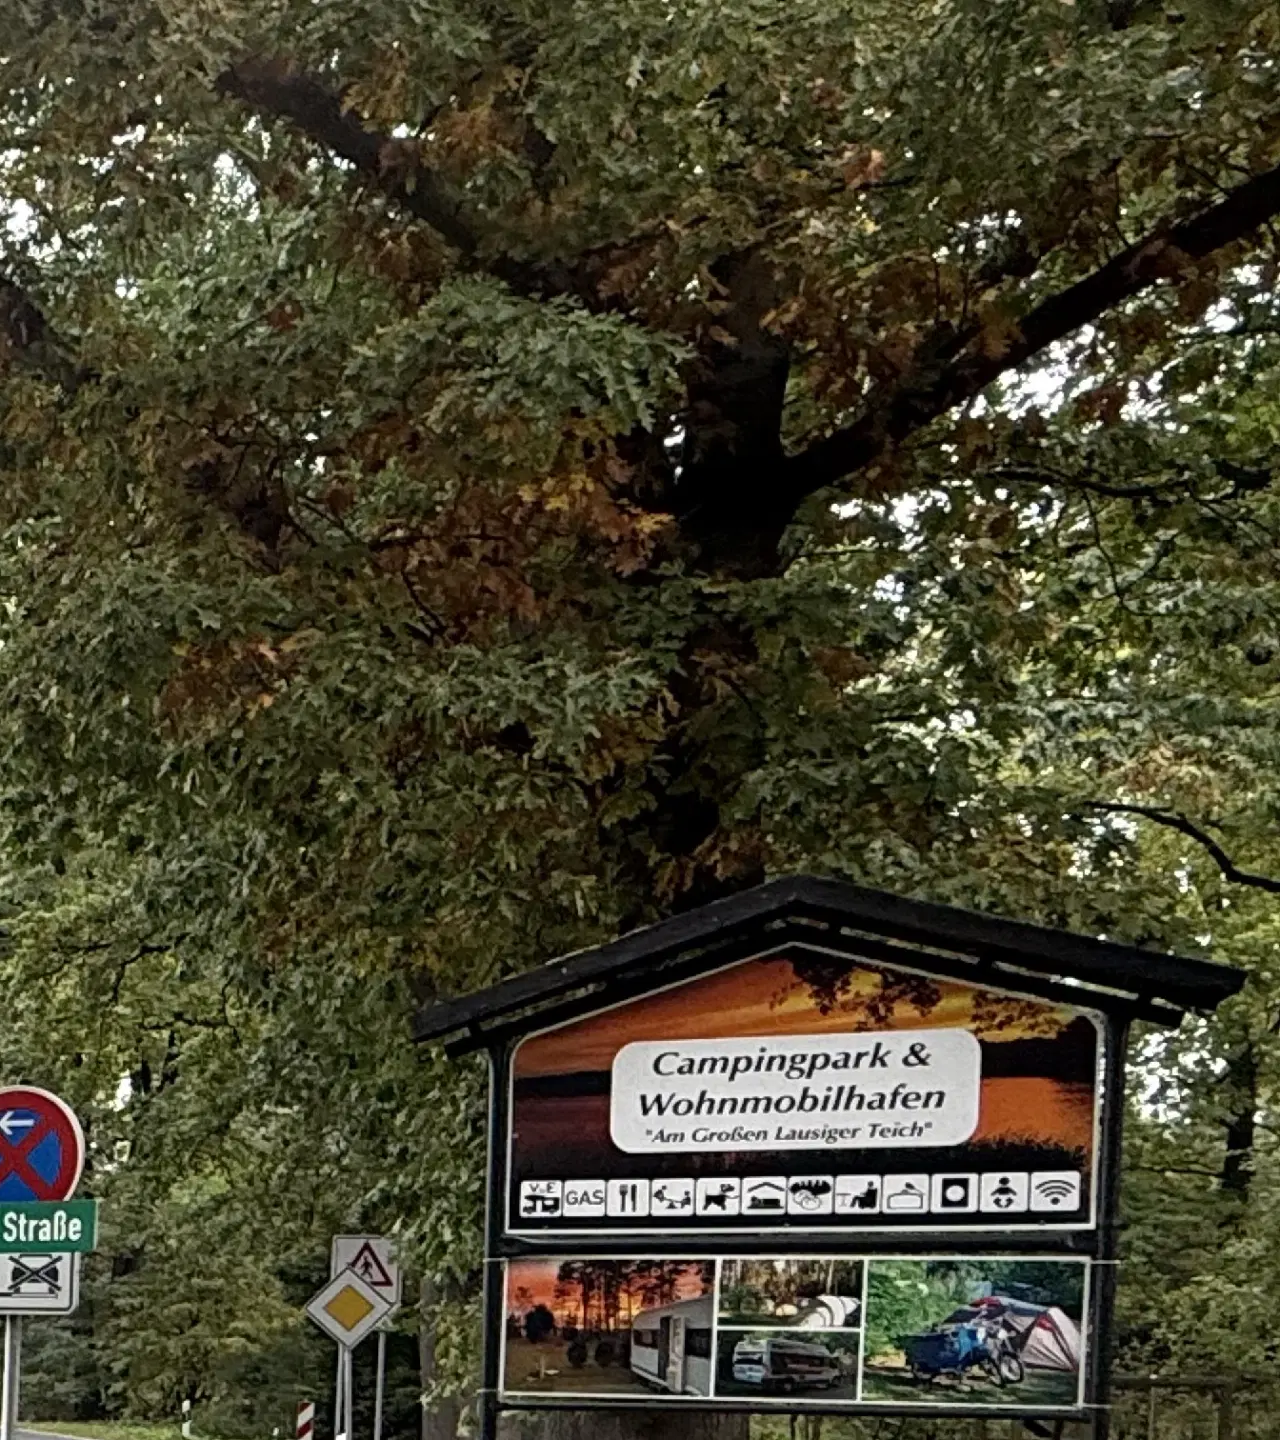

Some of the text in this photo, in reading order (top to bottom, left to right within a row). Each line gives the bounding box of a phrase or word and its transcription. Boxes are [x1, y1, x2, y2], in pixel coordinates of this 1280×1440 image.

[652, 1042, 931, 1081] Campingpark &
[639, 1083, 946, 1117] Wohnmobilhafen
[645, 1121, 933, 1143] "Am Großen Lausiger Teich"
[566, 1190, 604, 1206] GAS
[2, 1210, 83, 1242] Straße
